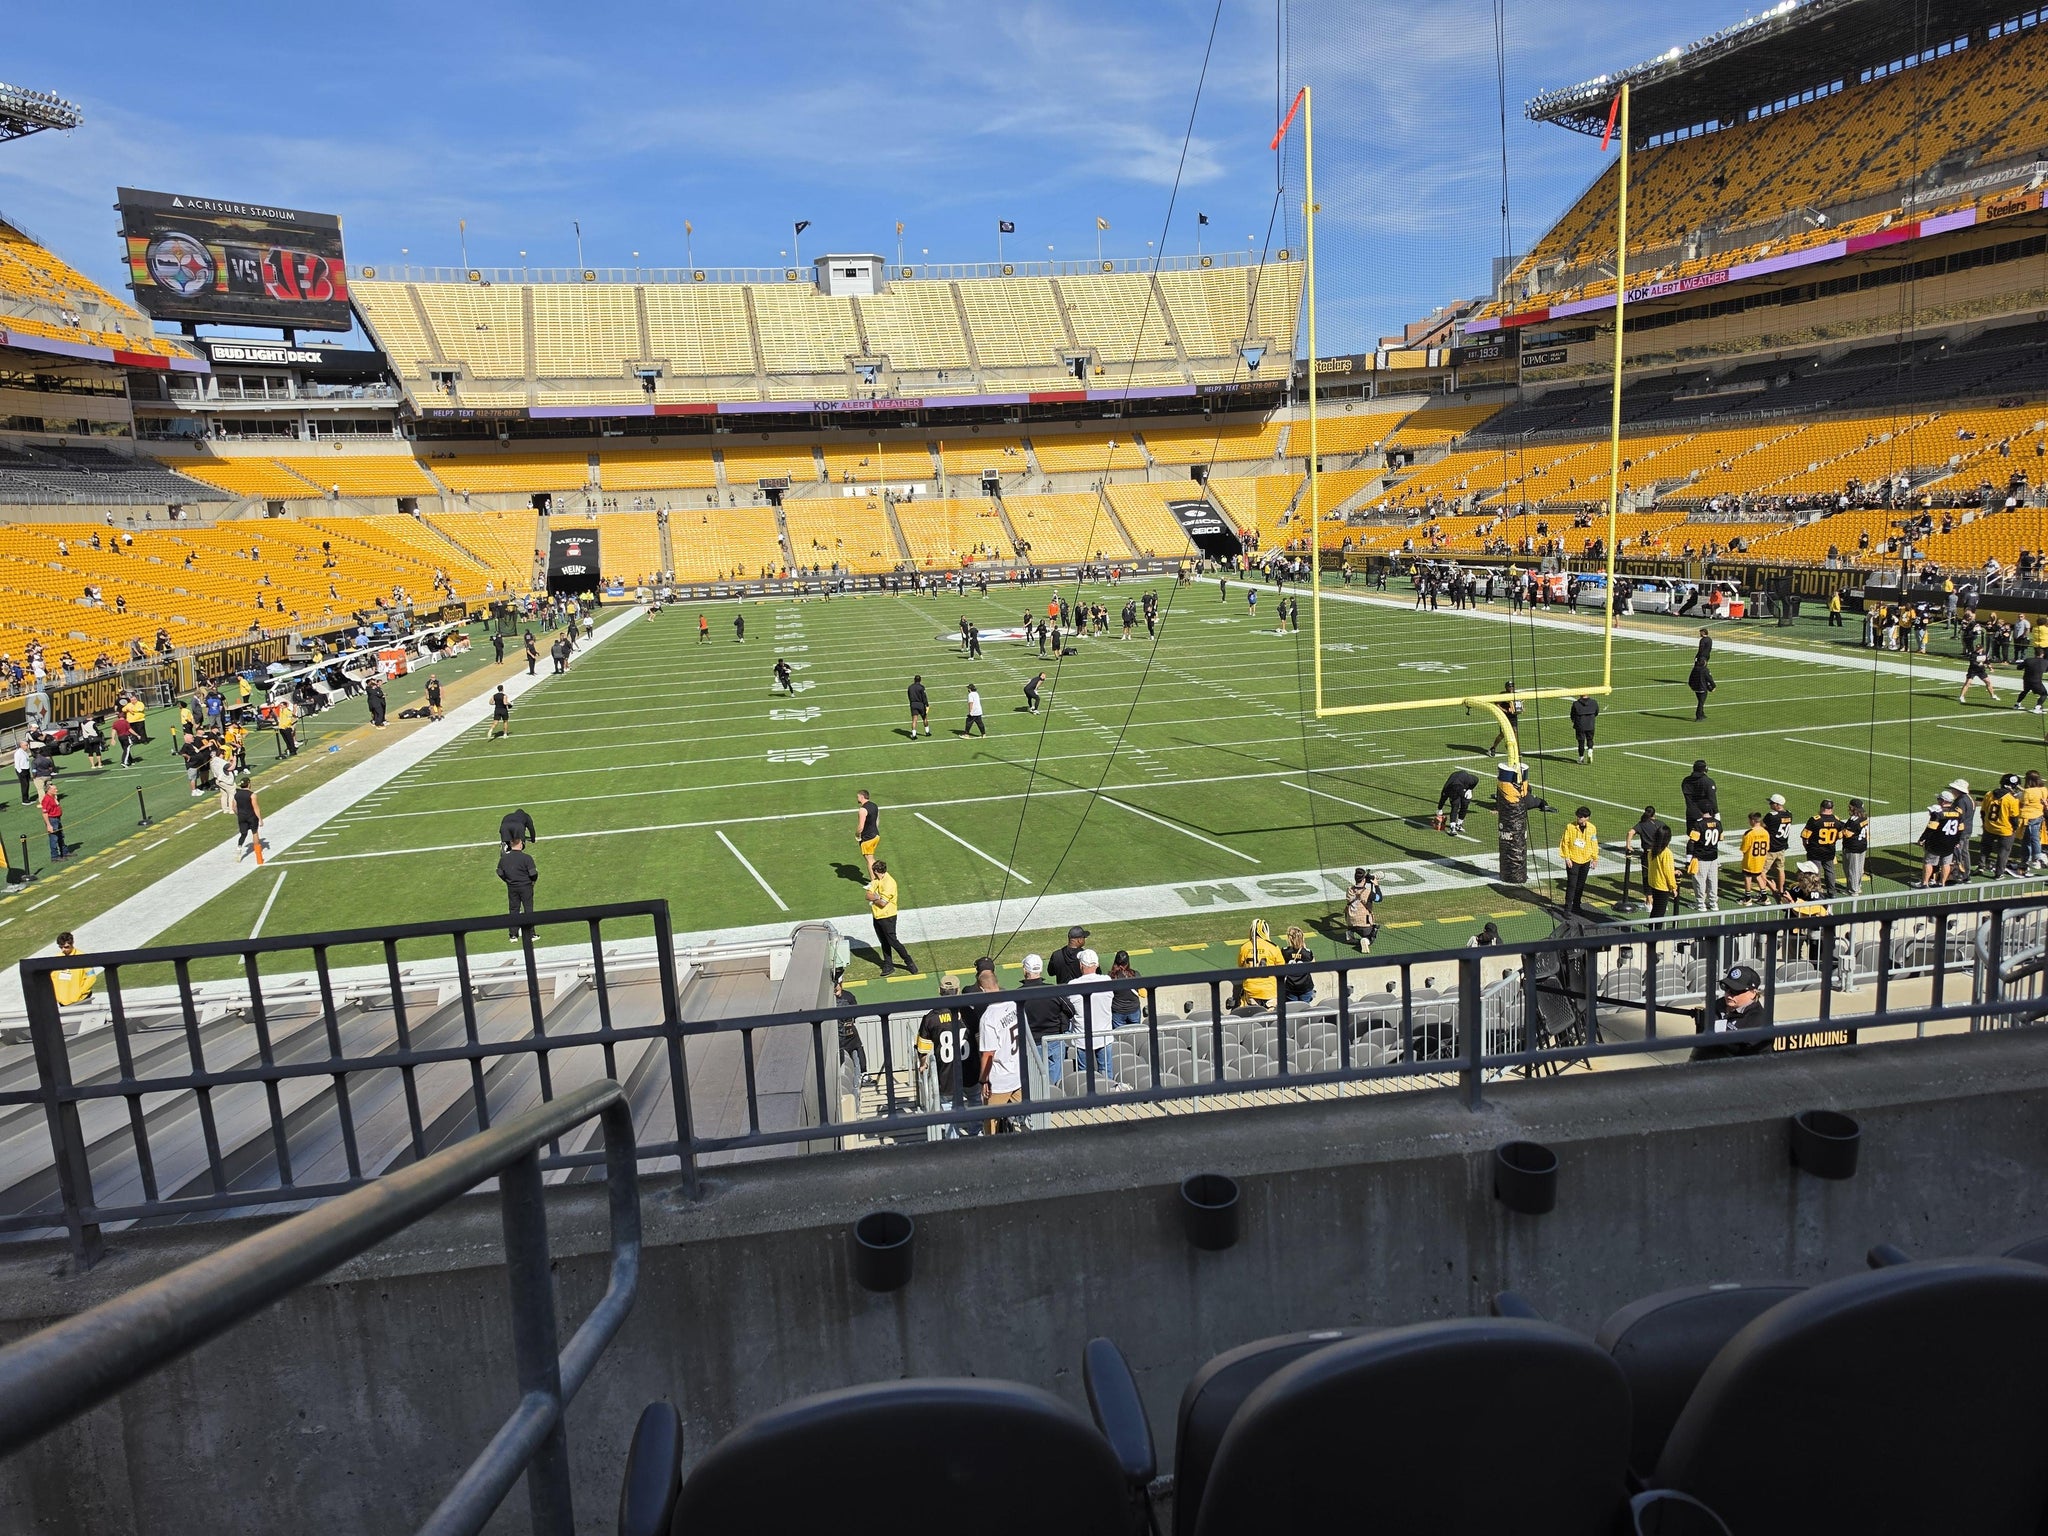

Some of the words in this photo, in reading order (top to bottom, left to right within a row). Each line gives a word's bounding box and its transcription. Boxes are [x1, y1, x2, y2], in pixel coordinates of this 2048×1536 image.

[187, 199, 247, 215] ACRISURE
[250, 207, 295, 221] STADIUM
[1986, 200, 2027, 219] Steelers
[231, 258, 258, 283] VS
[1651, 282, 1679, 296] ALERT
[1683, 271, 1726, 289] WEATHER
[214, 347, 245, 359] BUD
[245, 349, 285, 360] LIGHT
[287, 350, 323, 363] DECK
[1479, 347, 1499, 358] 1933
[1522, 354, 1548, 366] UPMC
[841, 401, 871, 409] ALERT
[875, 400, 919, 408] WEATHER
[433, 409, 454, 417] HELP?
[459, 409, 475, 417] TEXT
[561, 564, 587, 575] HEINZ
[1775, 823, 1790, 839] 50
[1942, 820, 1958, 835] 43
[1704, 828, 1719, 846] 90
[1818, 828, 1838, 844] 90
[1752, 841, 1767, 857] 88
[940, 1031, 970, 1063] 86
[1789, 1029, 1848, 1050] STANDING
